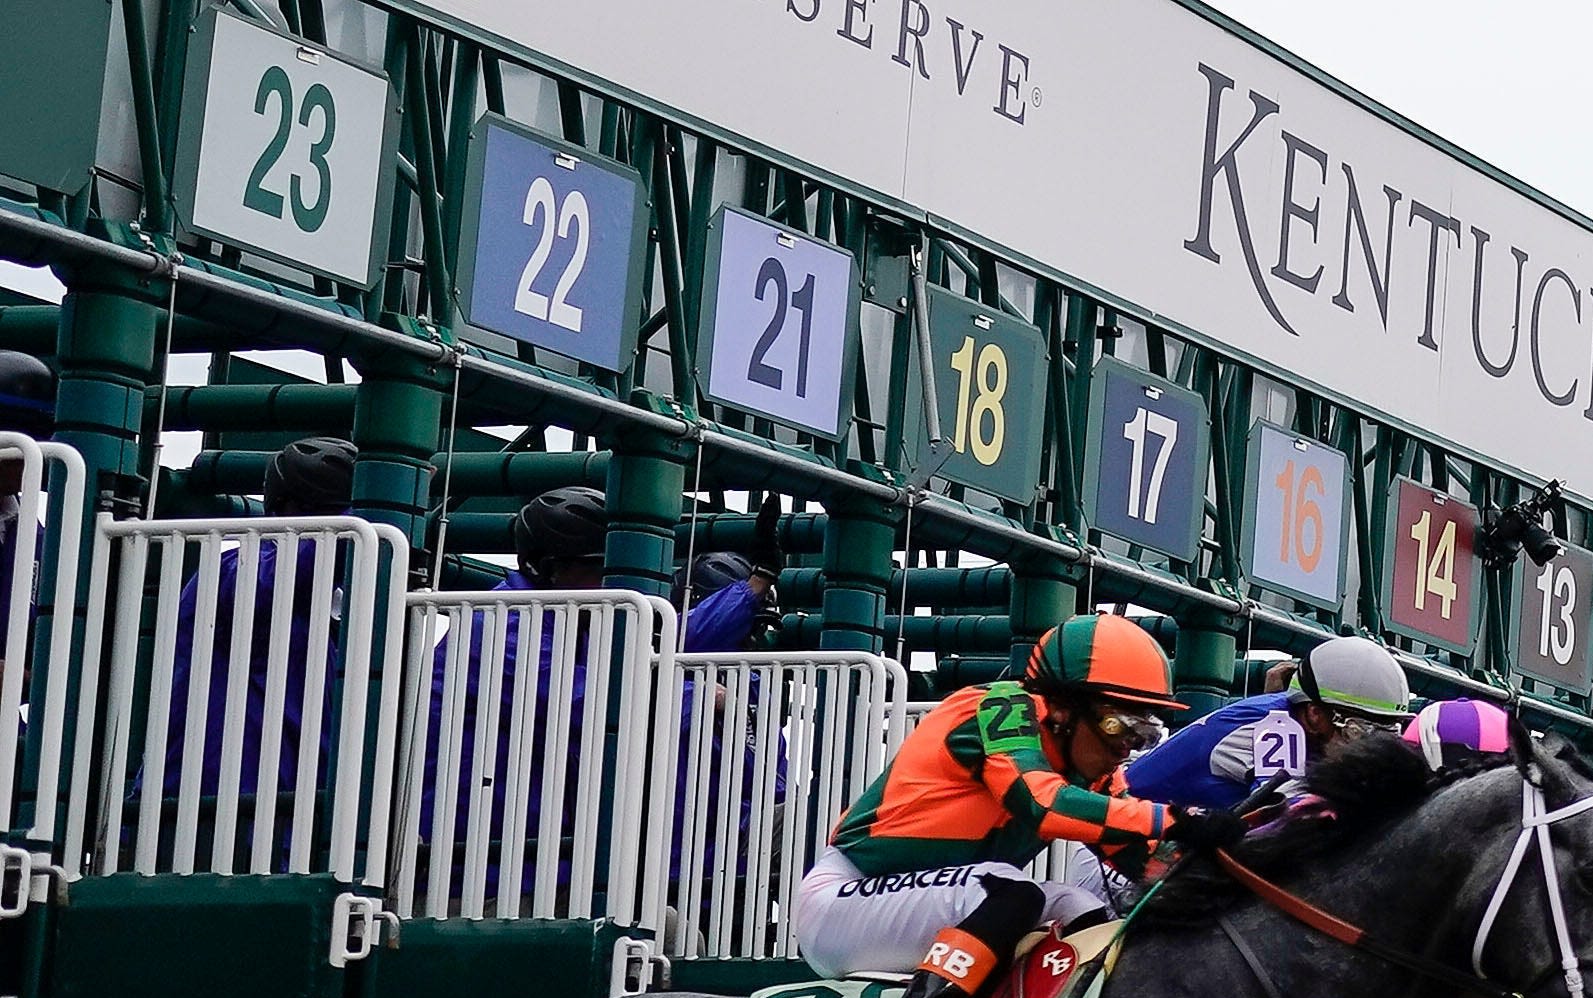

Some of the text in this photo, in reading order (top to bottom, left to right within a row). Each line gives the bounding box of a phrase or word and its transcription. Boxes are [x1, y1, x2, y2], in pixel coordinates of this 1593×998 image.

[243, 65, 337, 233] 23
[514, 176, 591, 333] 22
[746, 256, 816, 399] 21
[950, 334, 1009, 467] 18
[1122, 405, 1179, 525] 17
[1275, 458, 1325, 576] 16
[1409, 510, 1459, 621] 14
[1535, 566, 1578, 667] 13
[979, 695, 1038, 740] 23
[1261, 732, 1298, 770] 21
[923, 942, 976, 979] RB
